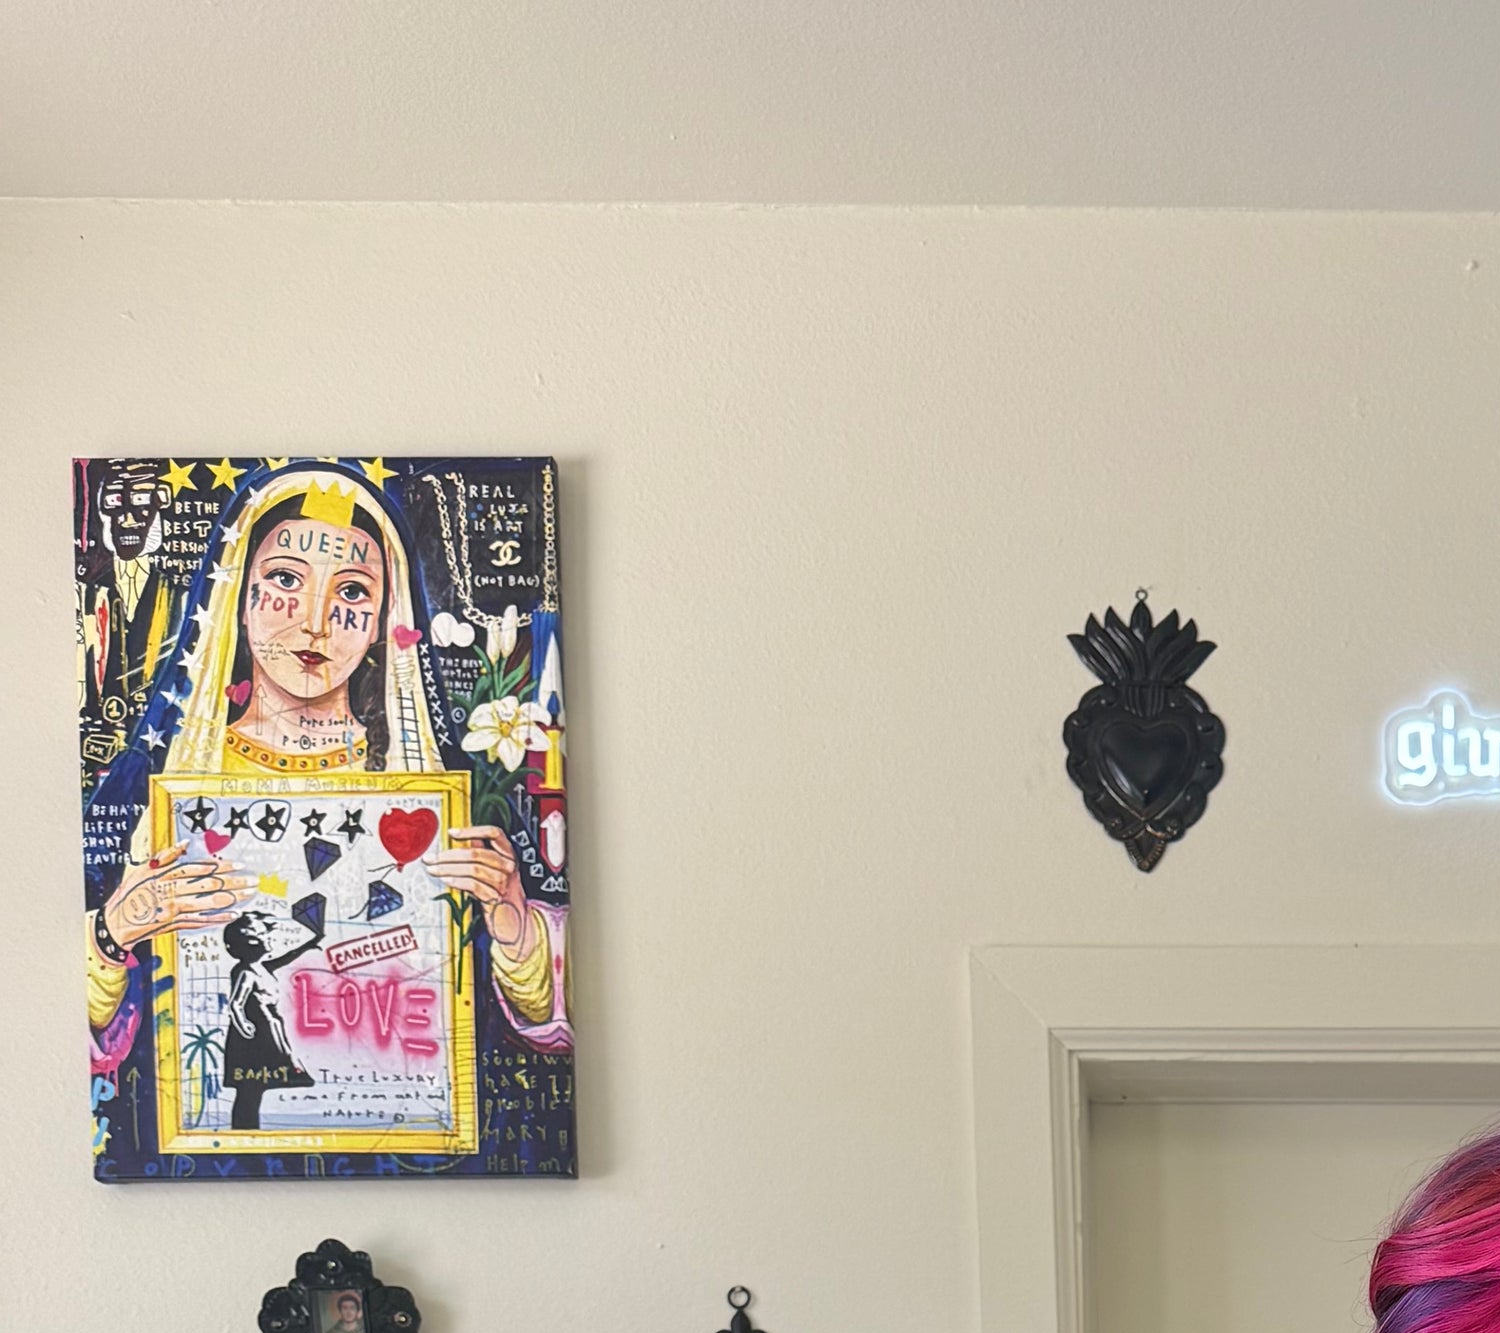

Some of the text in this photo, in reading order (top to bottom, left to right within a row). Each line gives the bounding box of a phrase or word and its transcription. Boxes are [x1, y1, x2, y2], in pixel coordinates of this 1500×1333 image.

[469, 485, 515, 498] REAL
[175, 501, 220, 515] BE THE
[277, 528, 370, 564] QUEEN
[327, 605, 373, 632] ART
[334, 934, 412, 967] CANCELLED
[294, 969, 437, 1056] LOVE
